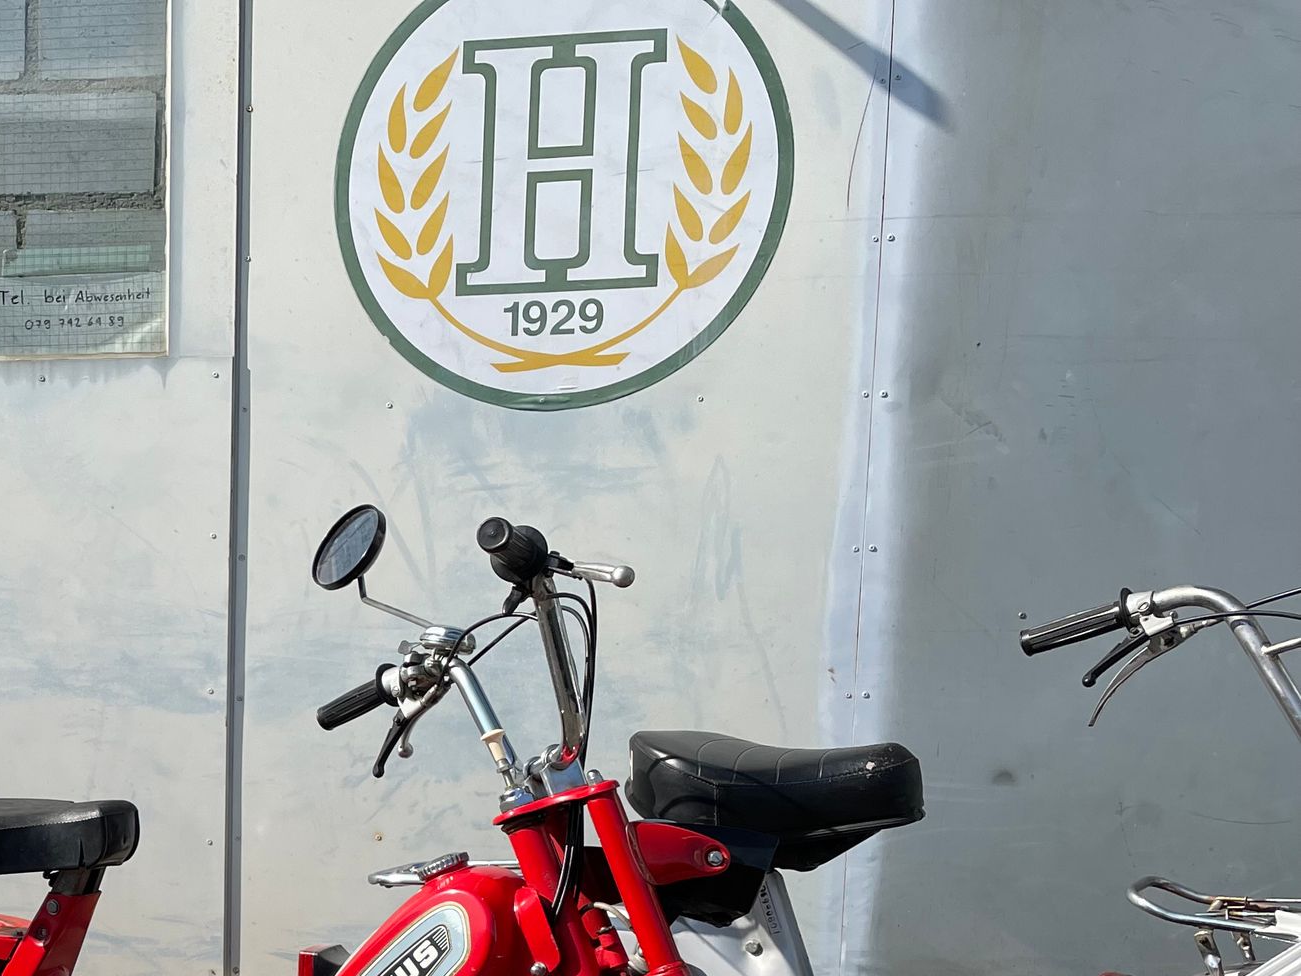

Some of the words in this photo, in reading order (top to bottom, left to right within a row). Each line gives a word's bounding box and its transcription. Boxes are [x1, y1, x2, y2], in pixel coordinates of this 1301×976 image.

[456, 28, 668, 296] H
[44, 289, 67, 303] bei
[74, 287, 151, 304] Abwesenheit
[24, 319, 51, 331] 079
[108, 315, 125, 327] 89
[503, 298, 605, 337] 1929
